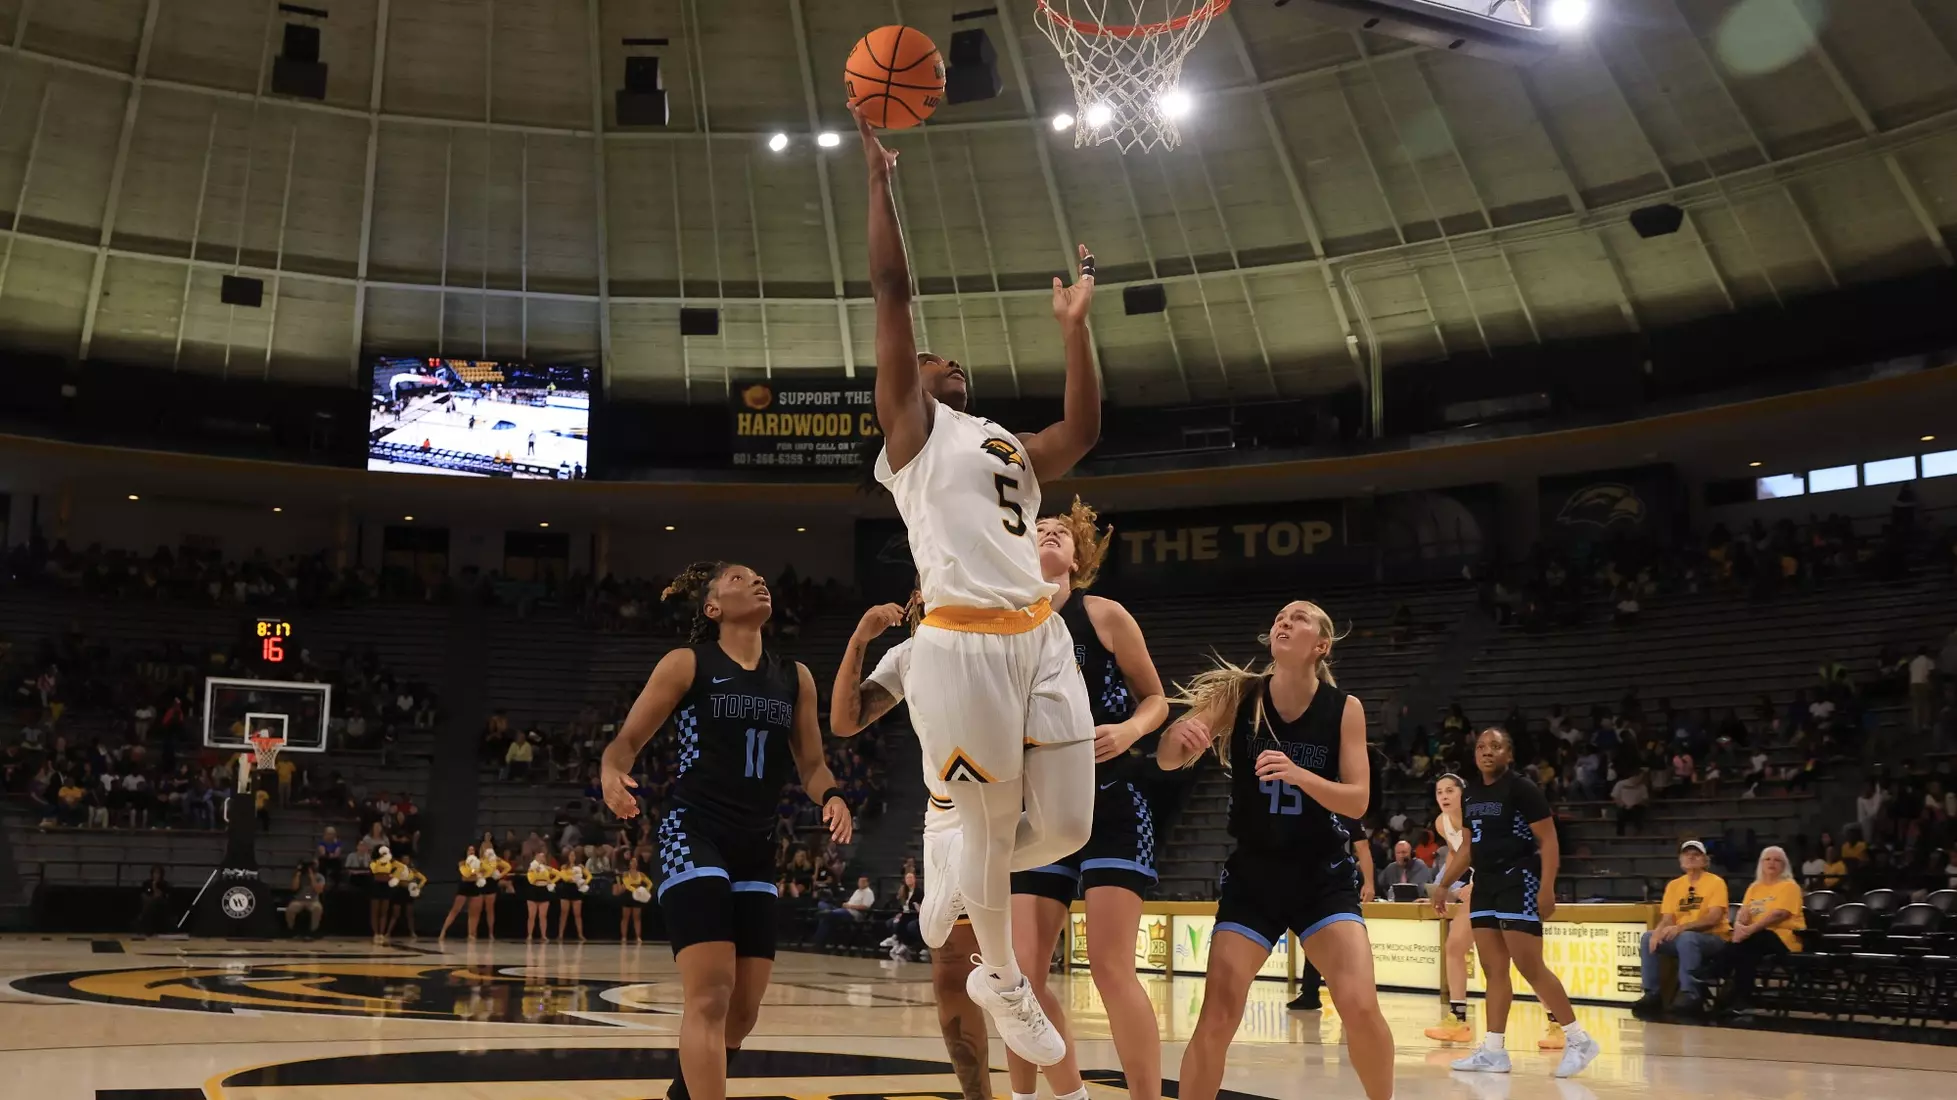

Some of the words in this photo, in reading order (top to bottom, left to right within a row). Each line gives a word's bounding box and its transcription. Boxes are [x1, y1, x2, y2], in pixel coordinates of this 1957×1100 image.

[779, 391, 841, 405] SUPPORT
[844, 391, 872, 404] THE
[737, 412, 852, 436] HARDWOOD
[815, 442, 836, 450] CALL
[992, 472, 1027, 537] 5
[1119, 526, 1221, 564] THE
[1233, 521, 1332, 557] TOP
[257, 622, 291, 637] 8:17
[263, 637, 284, 661] 16
[744, 728, 769, 779] 11
[1259, 778, 1303, 815] 45
[1568, 941, 1609, 964] MISS
[1571, 967, 1610, 996] APP
